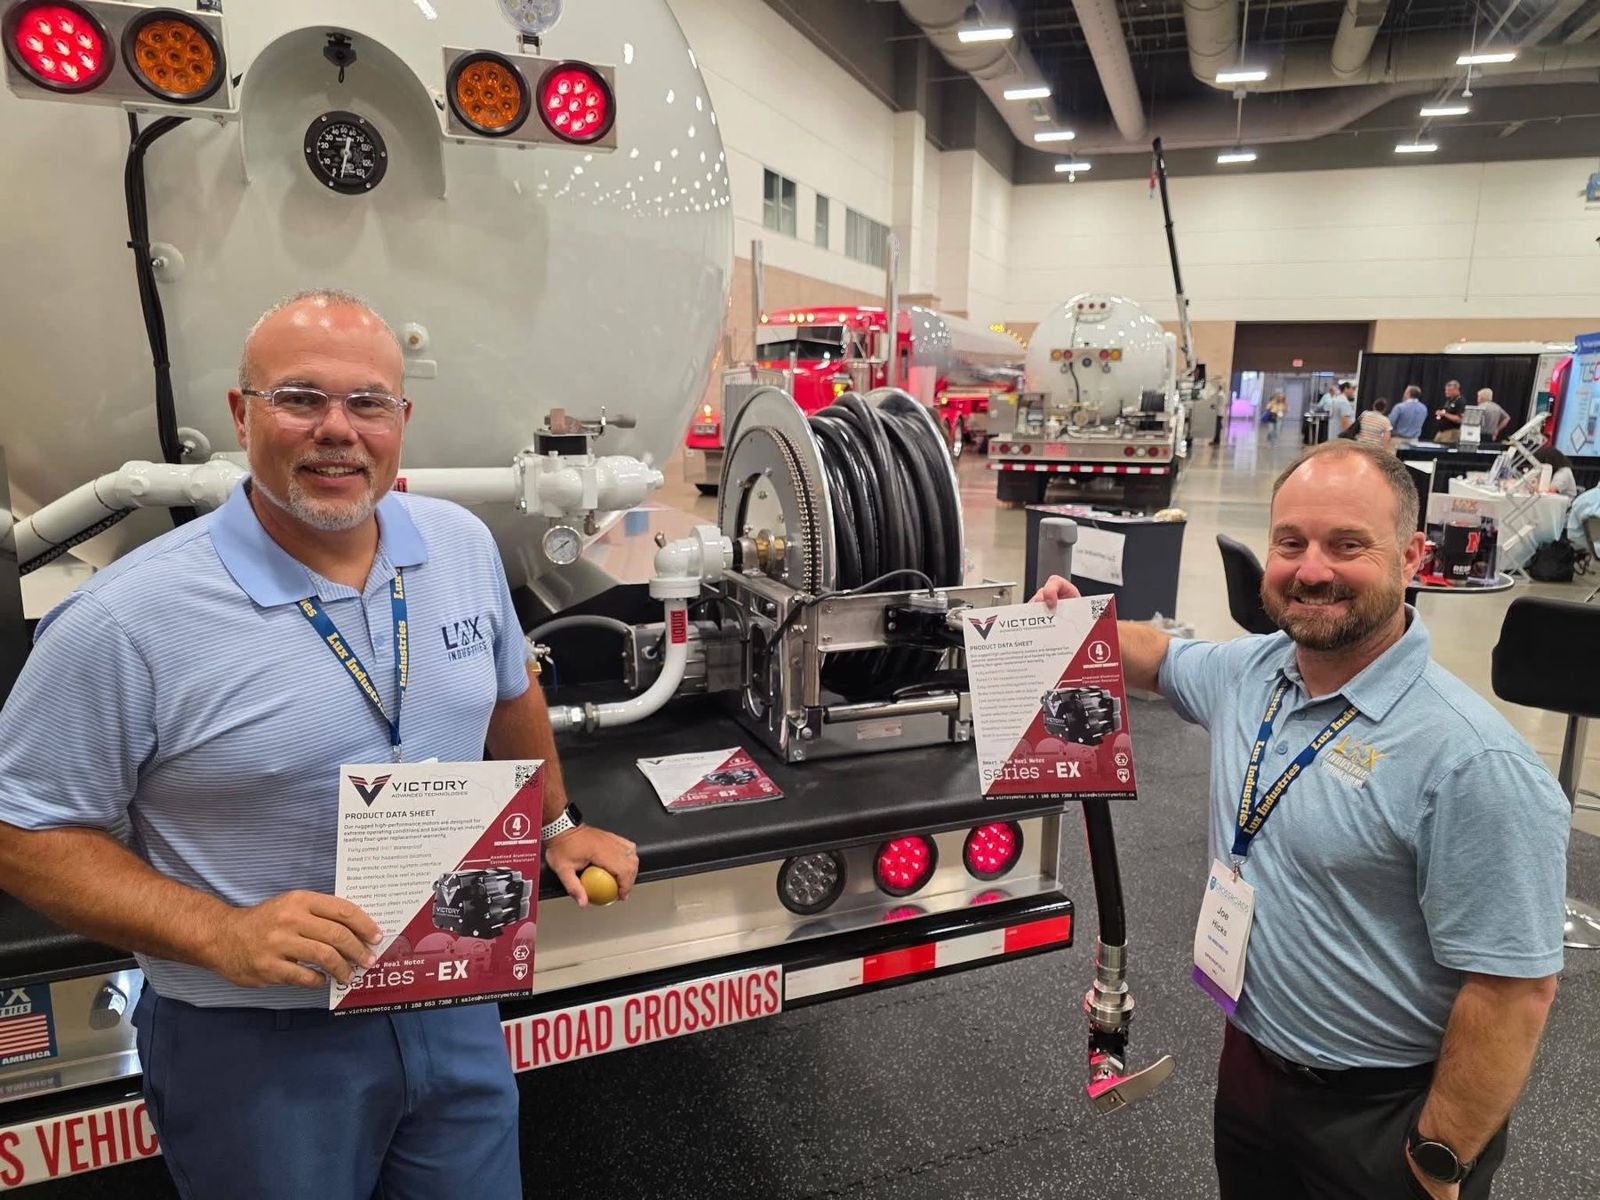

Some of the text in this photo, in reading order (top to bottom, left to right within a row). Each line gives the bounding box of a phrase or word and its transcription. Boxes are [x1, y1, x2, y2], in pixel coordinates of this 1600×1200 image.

[999, 616, 1055, 628] VICTORY
[396, 619, 408, 688] Industries
[970, 643, 996, 651] PRODUCT
[1095, 644, 1103, 656] 4
[326, 631, 388, 718] Lux Industr
[1311, 729, 1333, 751] Lux
[983, 764, 1040, 781] series
[392, 780, 468, 792] VICTORY
[1239, 740, 1265, 827] Lux Industries
[423, 790, 468, 798] TECHNOLOGIES
[1243, 763, 1300, 835] Lux Industries
[345, 809, 436, 820] PRODUCT DATA SHEET
[512, 817, 522, 831] 4
[435, 906, 461, 915] VICTORY
[1216, 906, 1230, 921] Joe
[1211, 920, 1228, 937] Hicks
[403, 959, 425, 967] Motor
[334, 1004, 401, 1017] www.victorymotor.ca
[461, 991, 530, 1004] sales@victorymotor.ca
[623, 968, 780, 1046] CROSSINGS
[1, 1050, 52, 1066] AMERICA
[34, 1102, 159, 1177] VEHIC
